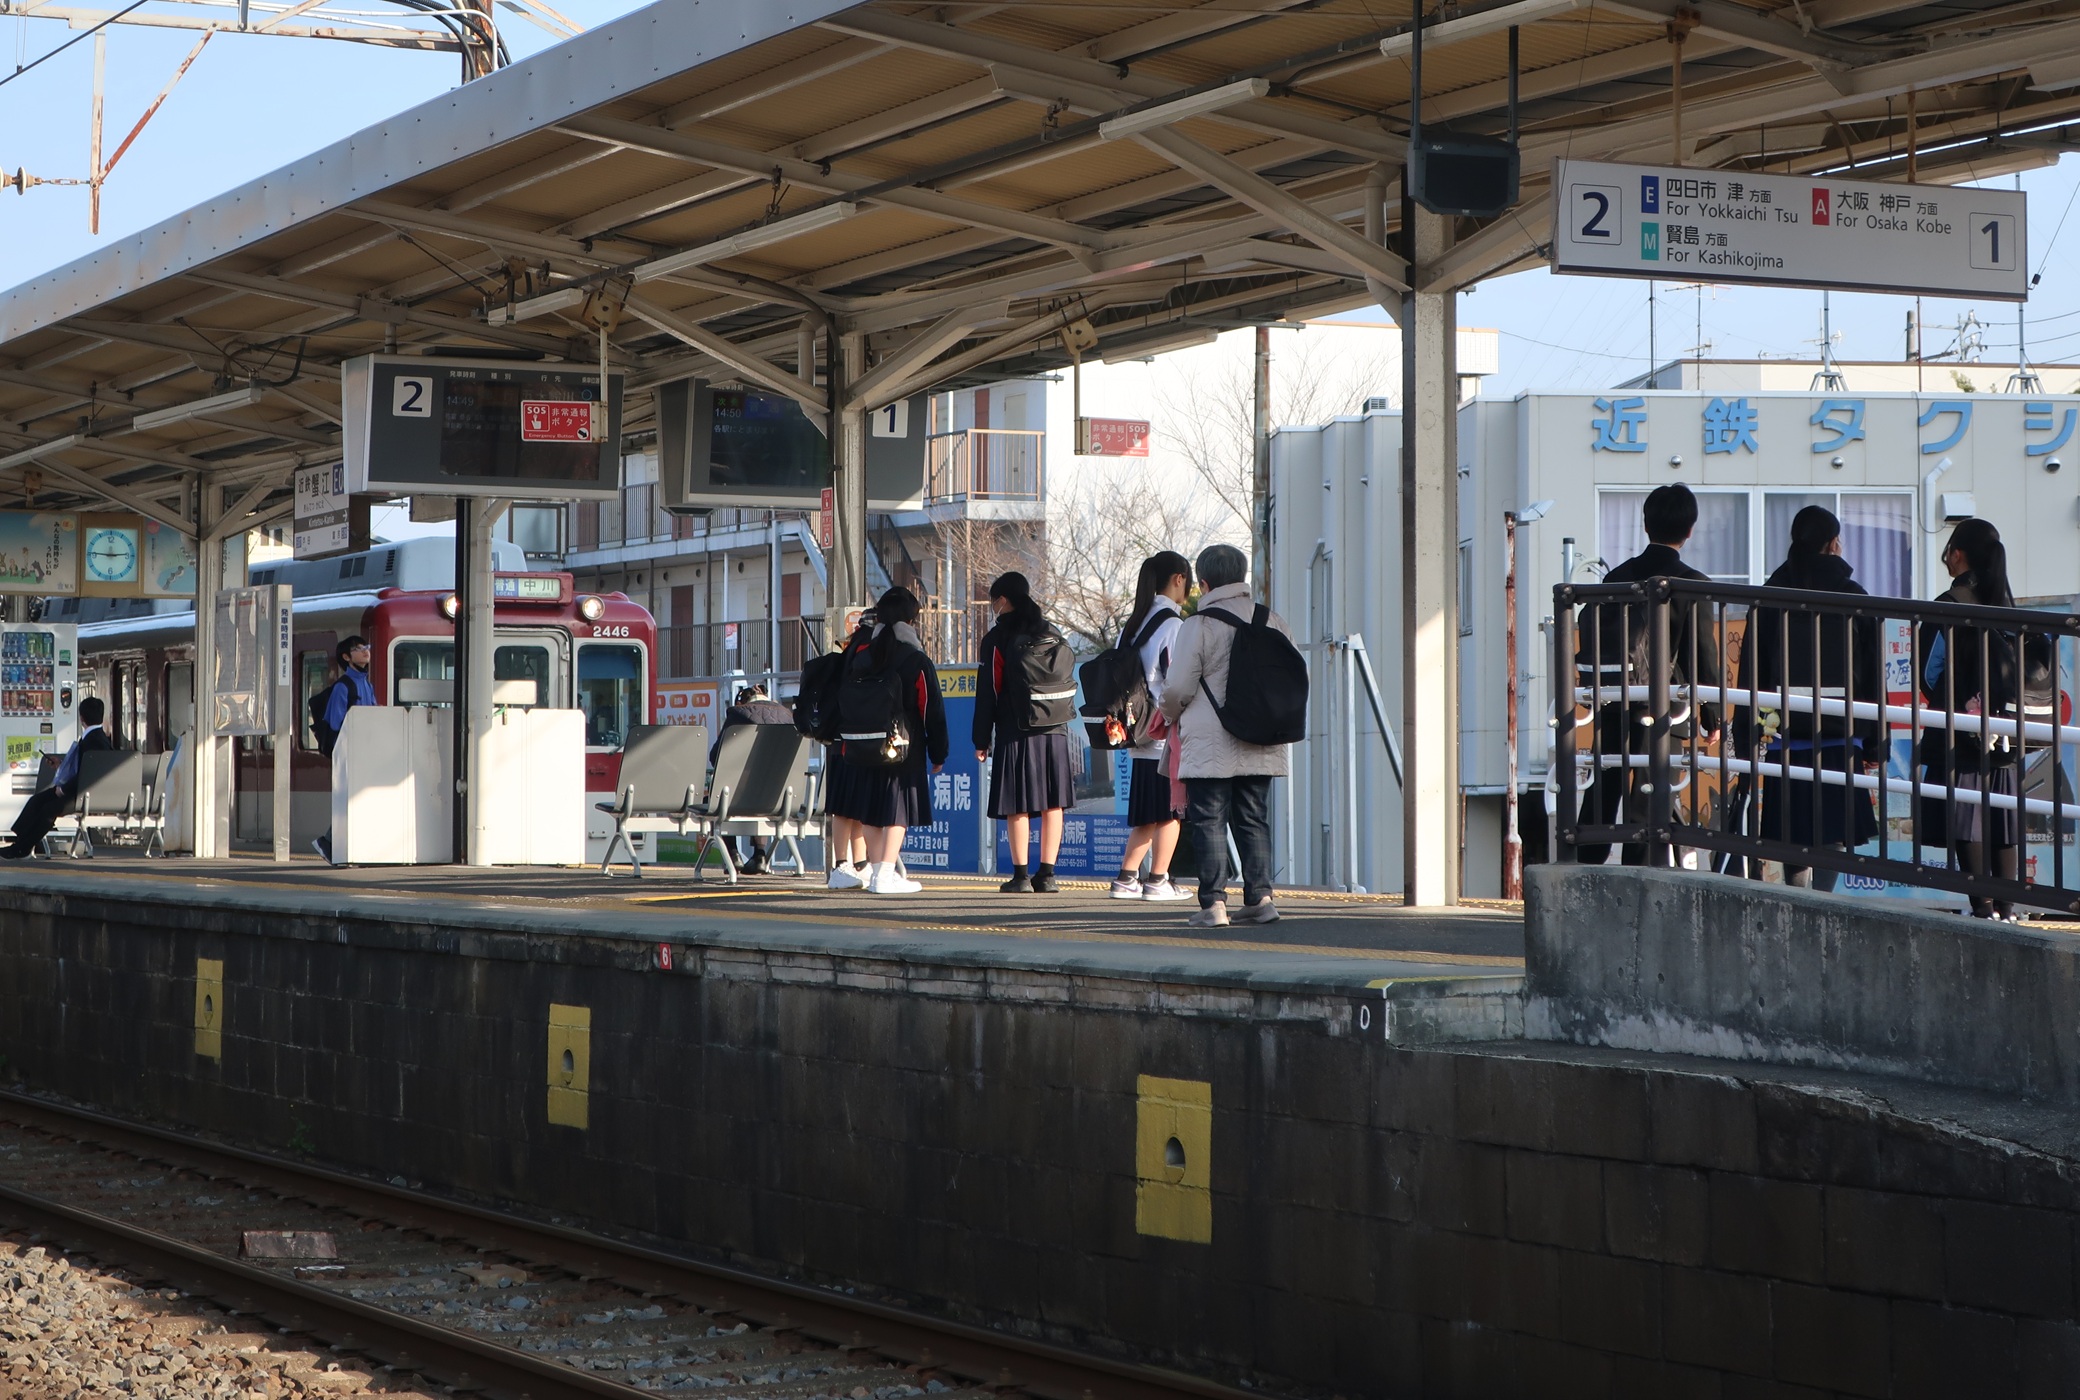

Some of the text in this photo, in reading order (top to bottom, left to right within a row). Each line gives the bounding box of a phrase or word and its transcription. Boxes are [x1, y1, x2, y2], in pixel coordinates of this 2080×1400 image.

[1645, 186, 1655, 204] E
[1666, 178, 1772, 204] 四日市 津 方面
[1815, 198, 1828, 216] A
[1836, 190, 1939, 216] 大阪 神戸 方面
[1581, 191, 1611, 238] 2
[1666, 201, 1799, 224] For Yokkaichi Tsu
[1836, 213, 1952, 235] For Osaka Kobe
[1644, 233, 1656, 250] M
[1666, 224, 1729, 247] 賢島 方面
[1981, 220, 1999, 263] 1
[1666, 248, 1785, 271] For Kashikojima
[449, 370, 476, 380] 発車時刻
[541, 374, 562, 383] 行先
[401, 380, 423, 412] 2
[526, 406, 547, 415] SOS
[551, 408, 589, 418] 非常通報
[714, 407, 742, 418] 14:50
[883, 403, 896, 433] 1
[551, 418, 588, 427] ボタン
[1092, 424, 1125, 434] 非常通報
[1128, 425, 1146, 434] SOS
[1092, 434, 1125, 442] ボタン
[107, 536, 115, 544] 12
[107, 566, 113, 576] 6
[494, 578, 516, 592] 普通
[523, 578, 554, 592] 中川
[280, 608, 289, 649] 発車時刻表
[593, 625, 630, 637] 2446
[662, 946, 669, 966] 6
